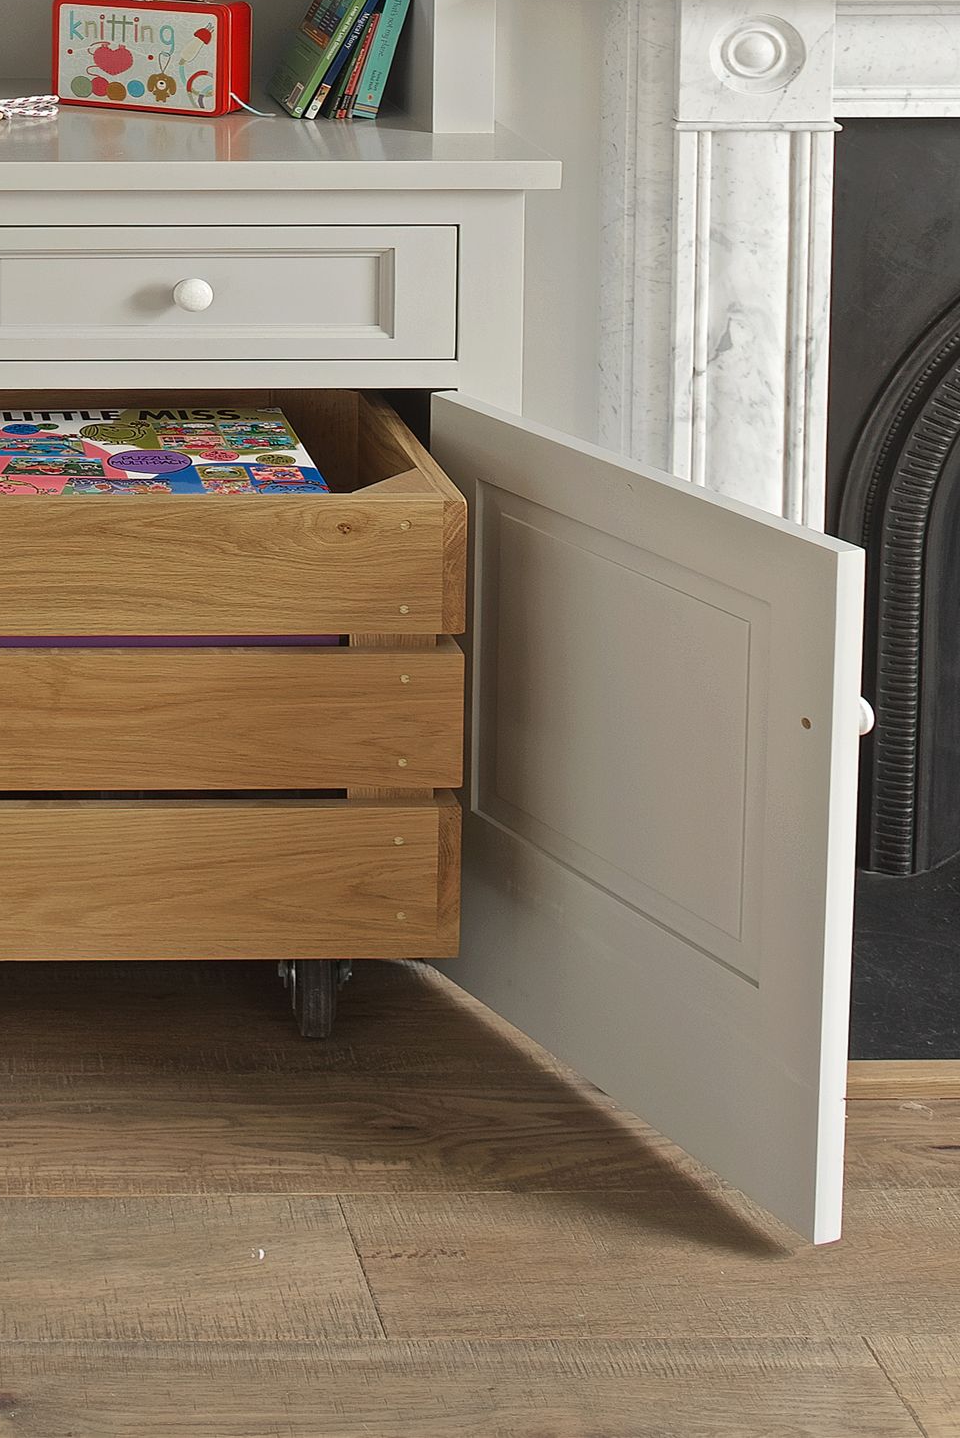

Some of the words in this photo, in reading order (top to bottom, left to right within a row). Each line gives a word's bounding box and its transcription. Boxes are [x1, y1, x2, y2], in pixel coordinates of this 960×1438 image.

[69, 10, 175, 56] knitting
[352, 10, 371, 36] Magical
[343, 33, 359, 51] Story
[2, 410, 121, 421] LITTLE
[137, 409, 241, 421] MISS
